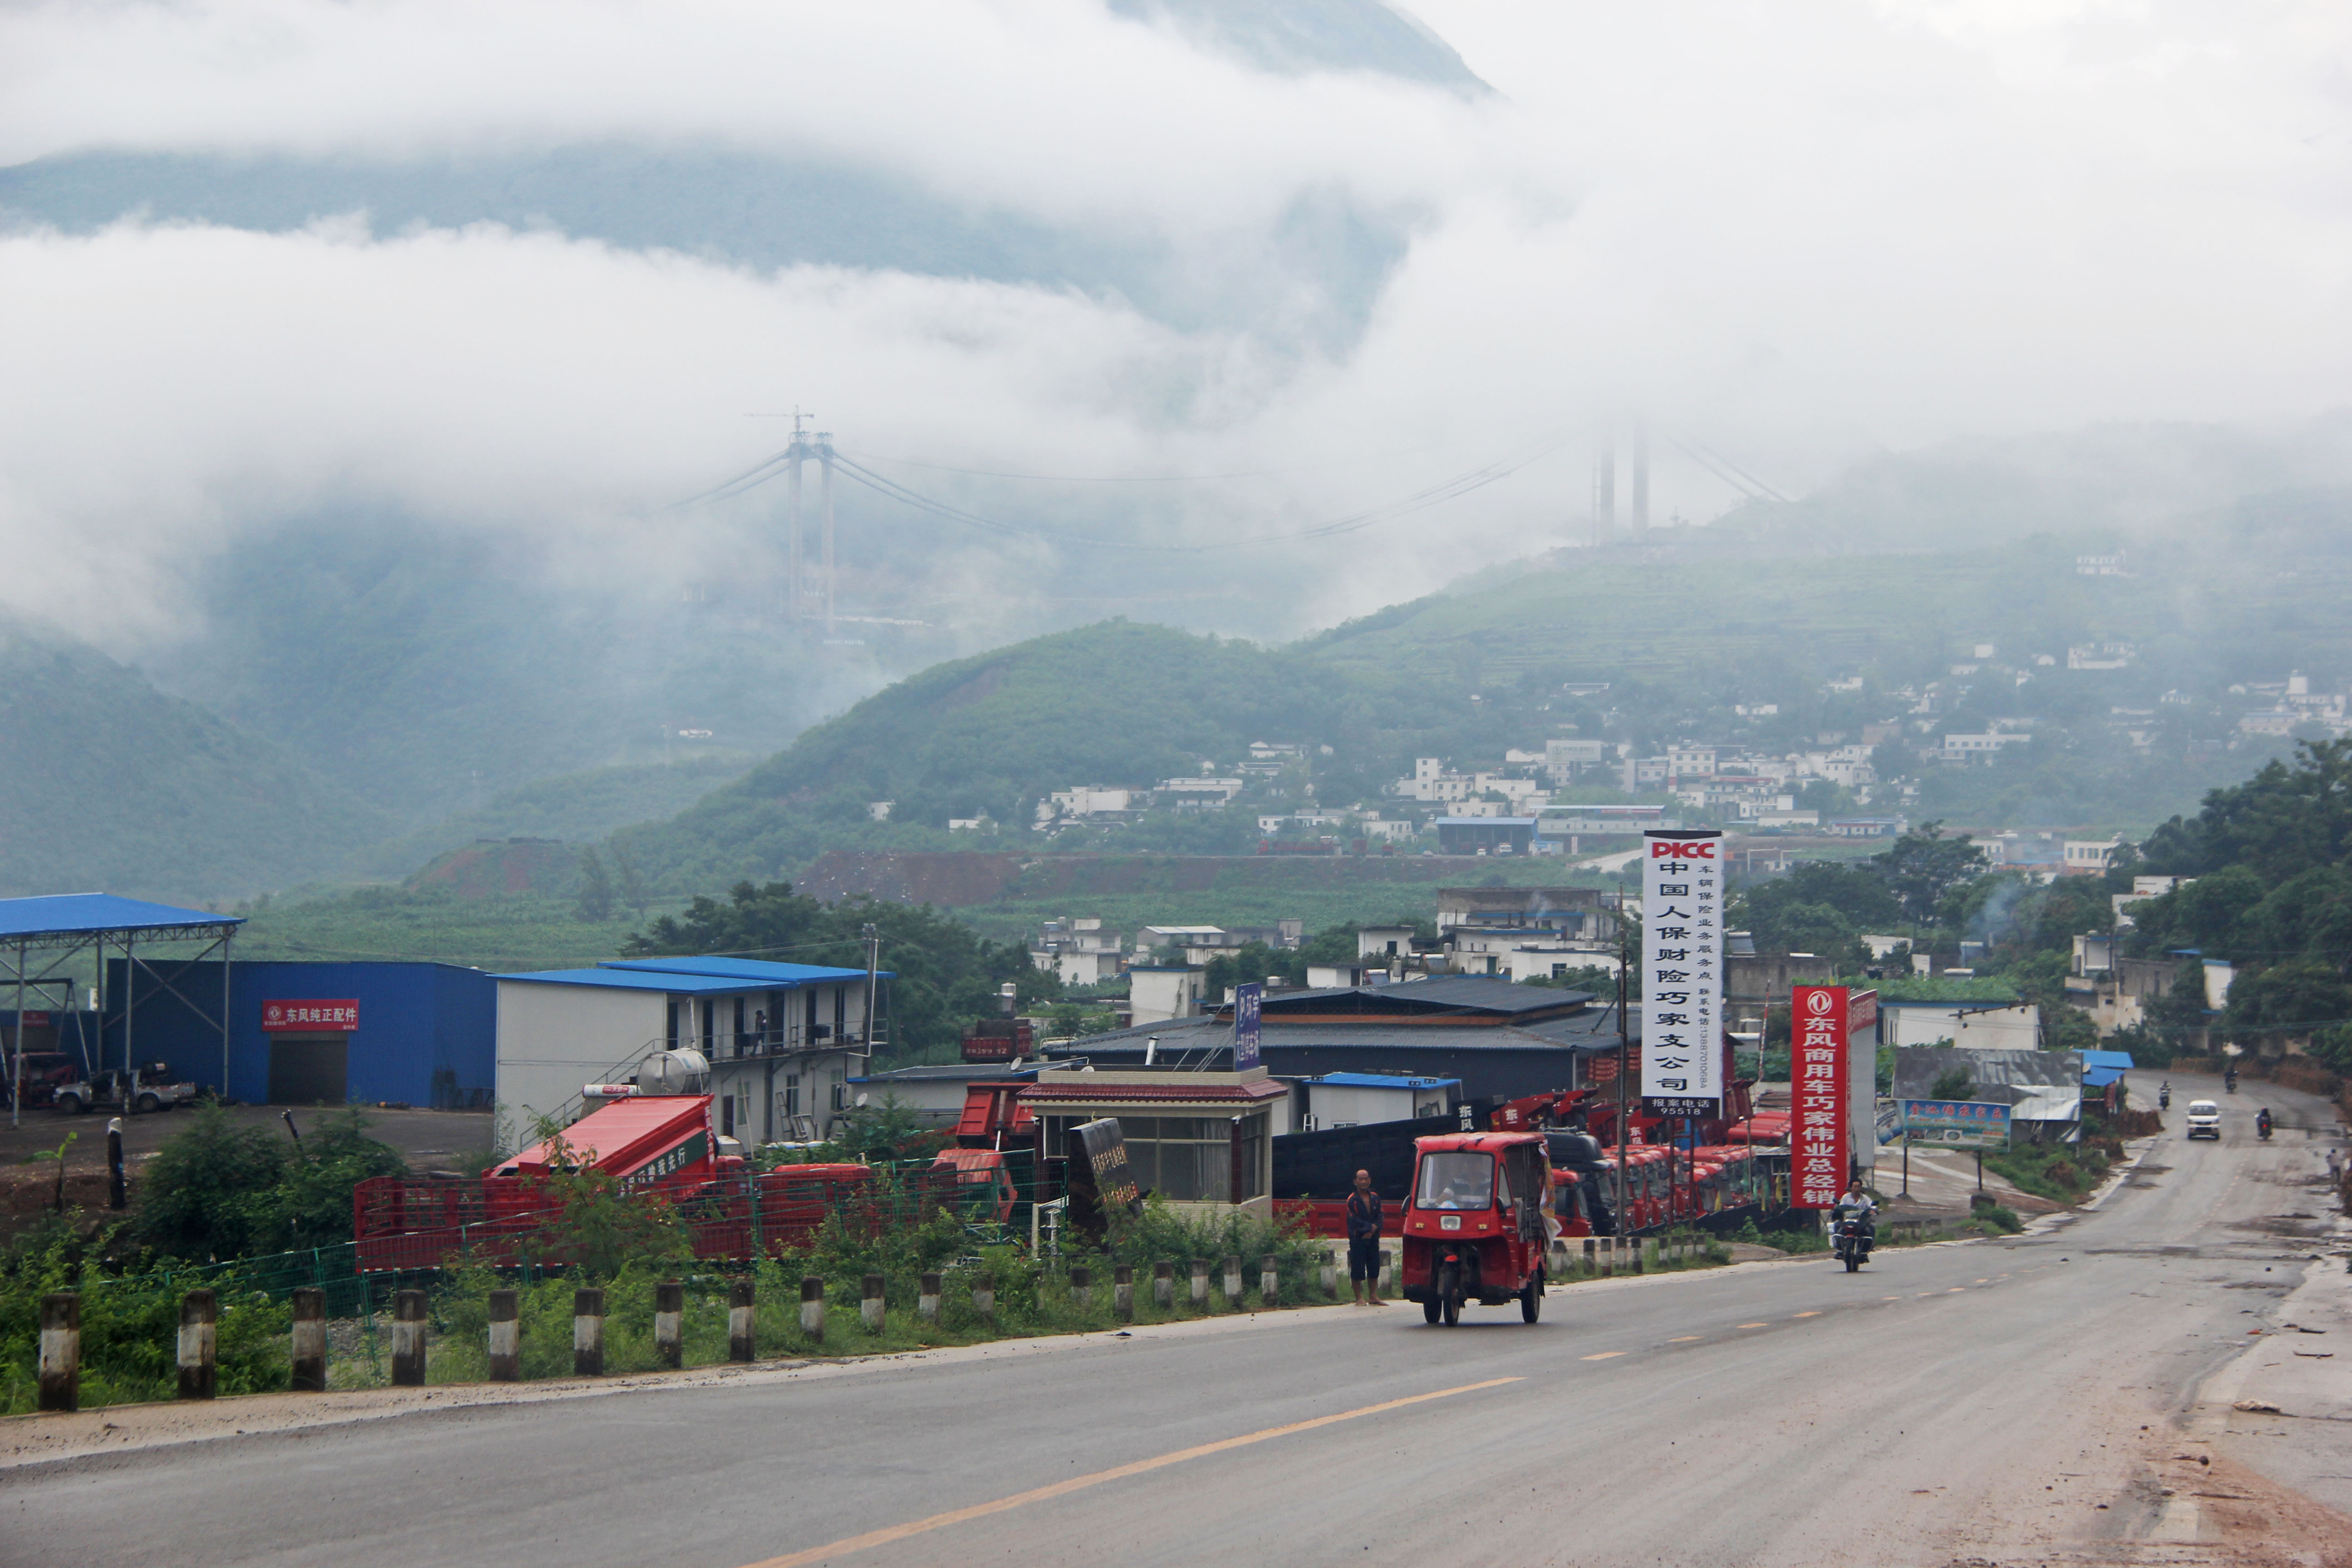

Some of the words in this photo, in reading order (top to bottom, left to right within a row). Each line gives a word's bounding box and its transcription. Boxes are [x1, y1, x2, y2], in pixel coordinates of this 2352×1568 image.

[1652, 843, 1715, 858] PICC
[1697, 866, 1714, 980] 车辆保险业务服务点
[1655, 862, 1691, 1091] 中国人保财险巧家支公司
[286, 1008, 356, 1022] 东风纯正配件
[1651, 1098, 1710, 1107] 报案电话
[1802, 1017, 1837, 1204] 东风商用车巧家伟业总经销
[1458, 1106, 1474, 1131] 东风
